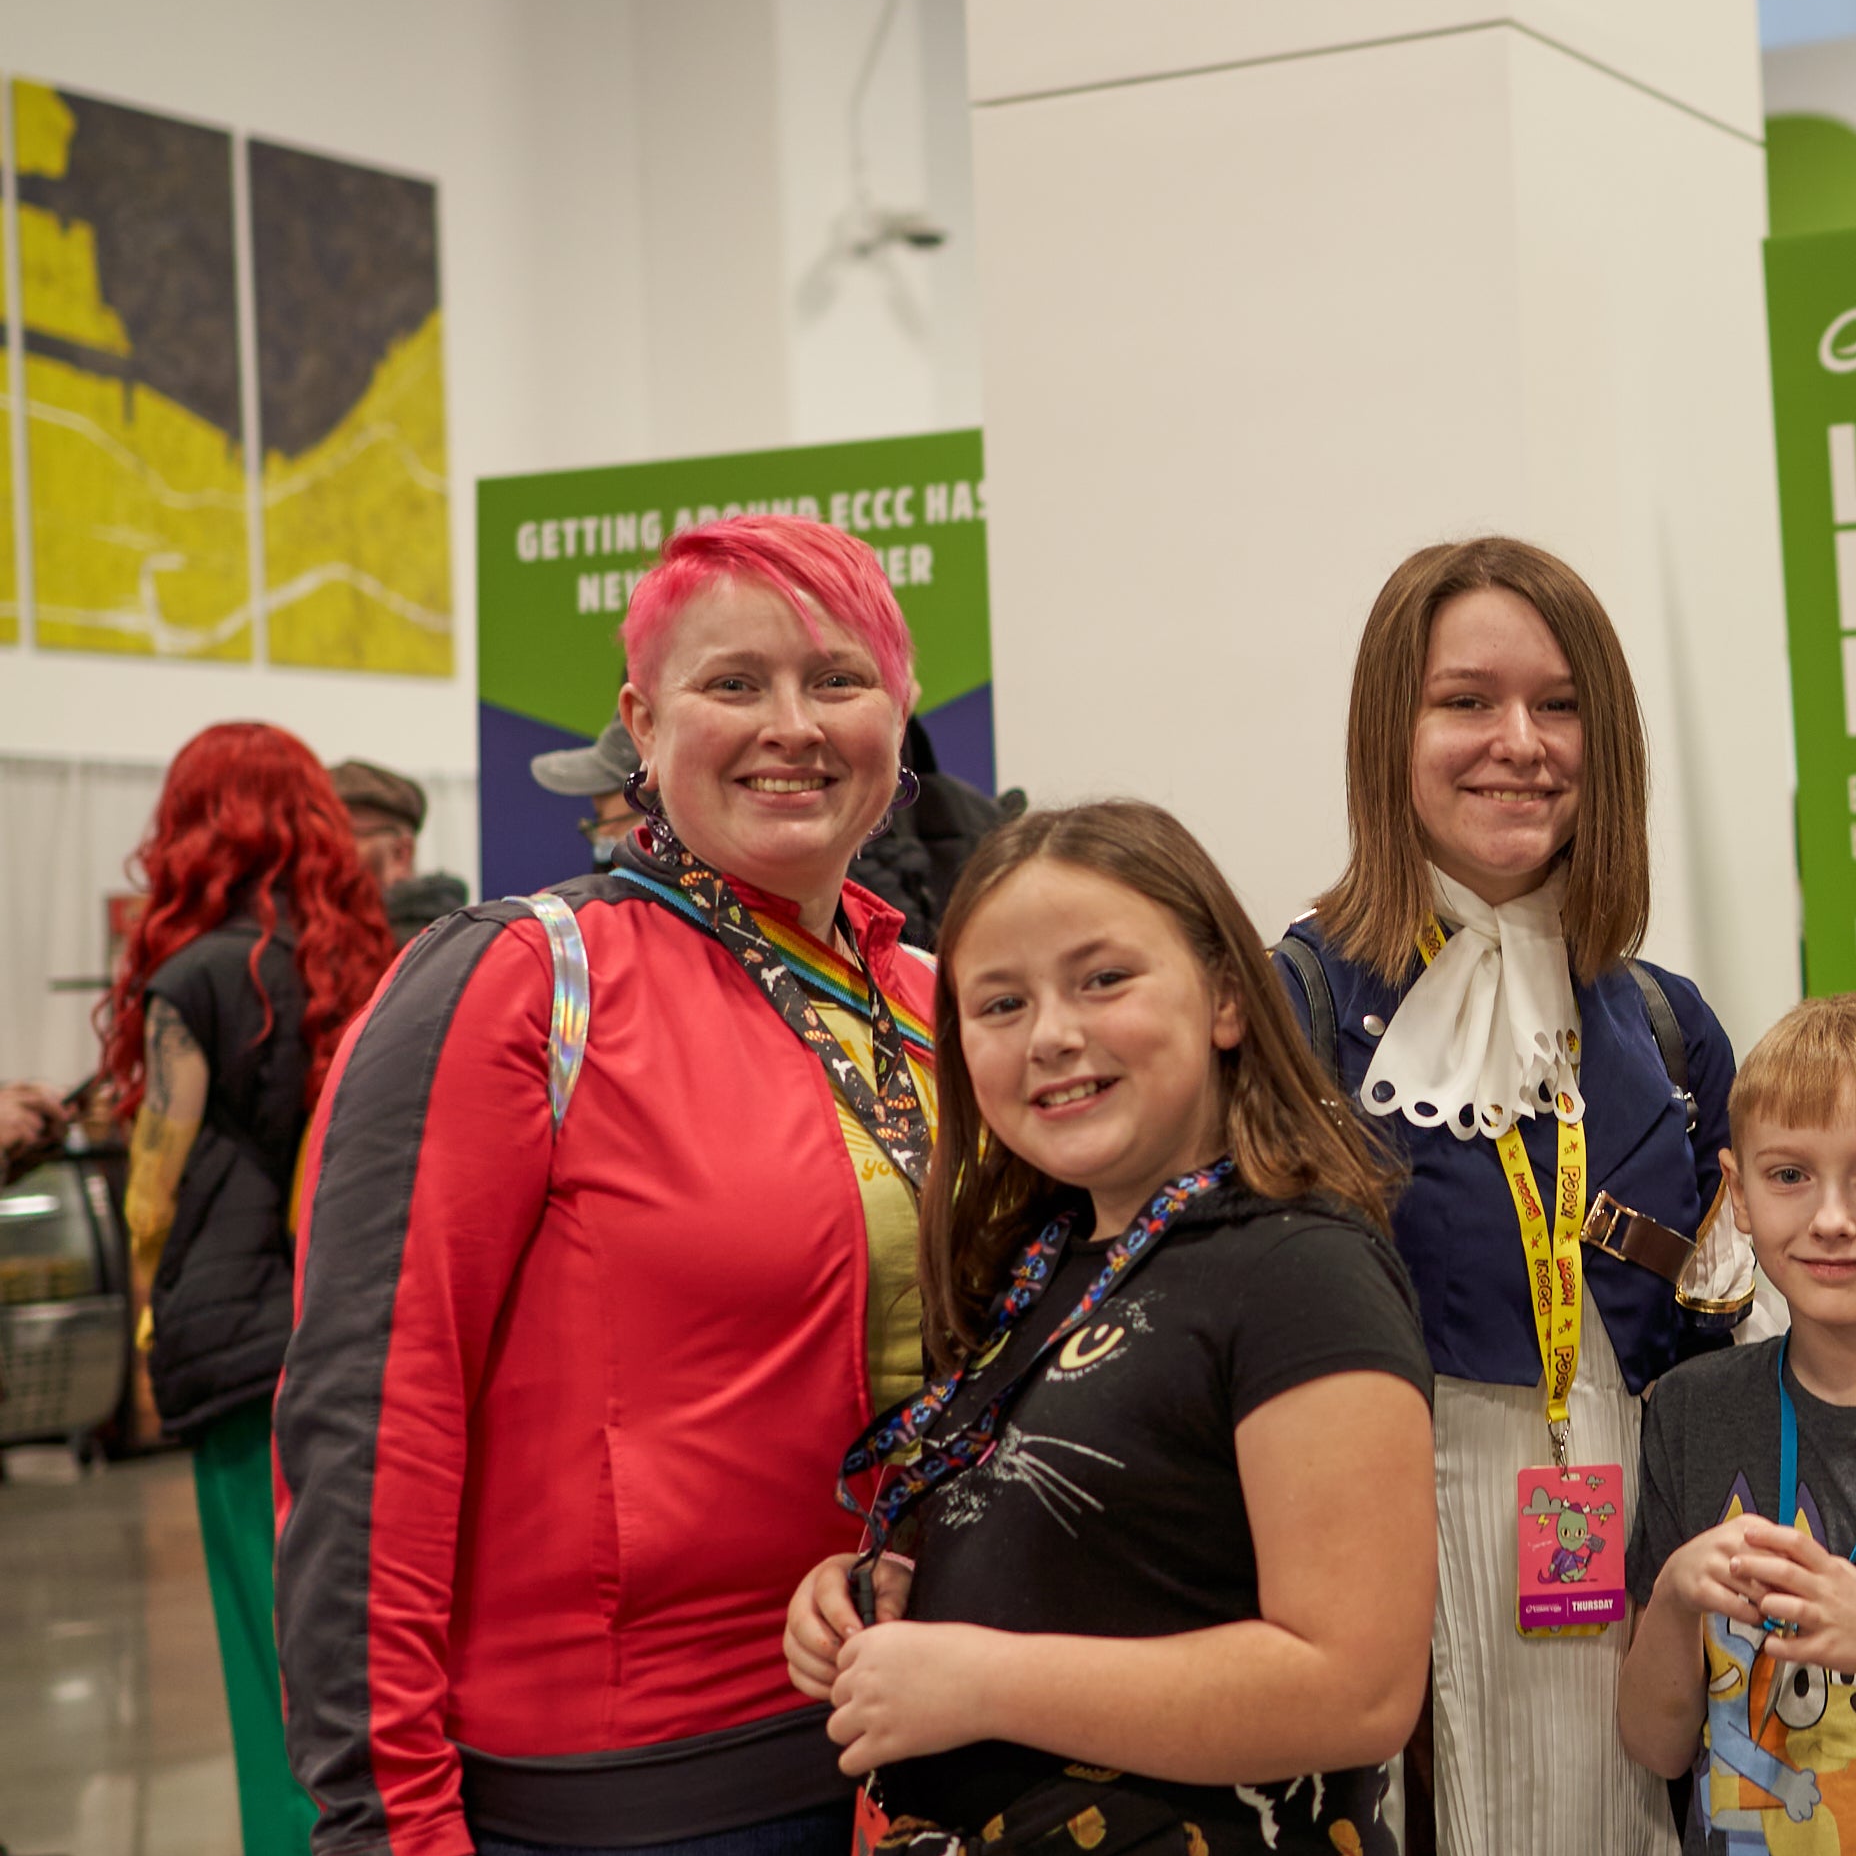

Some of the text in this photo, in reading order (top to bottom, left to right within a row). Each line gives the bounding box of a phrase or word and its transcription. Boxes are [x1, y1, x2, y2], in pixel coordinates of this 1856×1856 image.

[516, 510, 663, 562] GETTING
[829, 486, 914, 531] ECCC
[1571, 1599, 1613, 1612] THURSDAY
